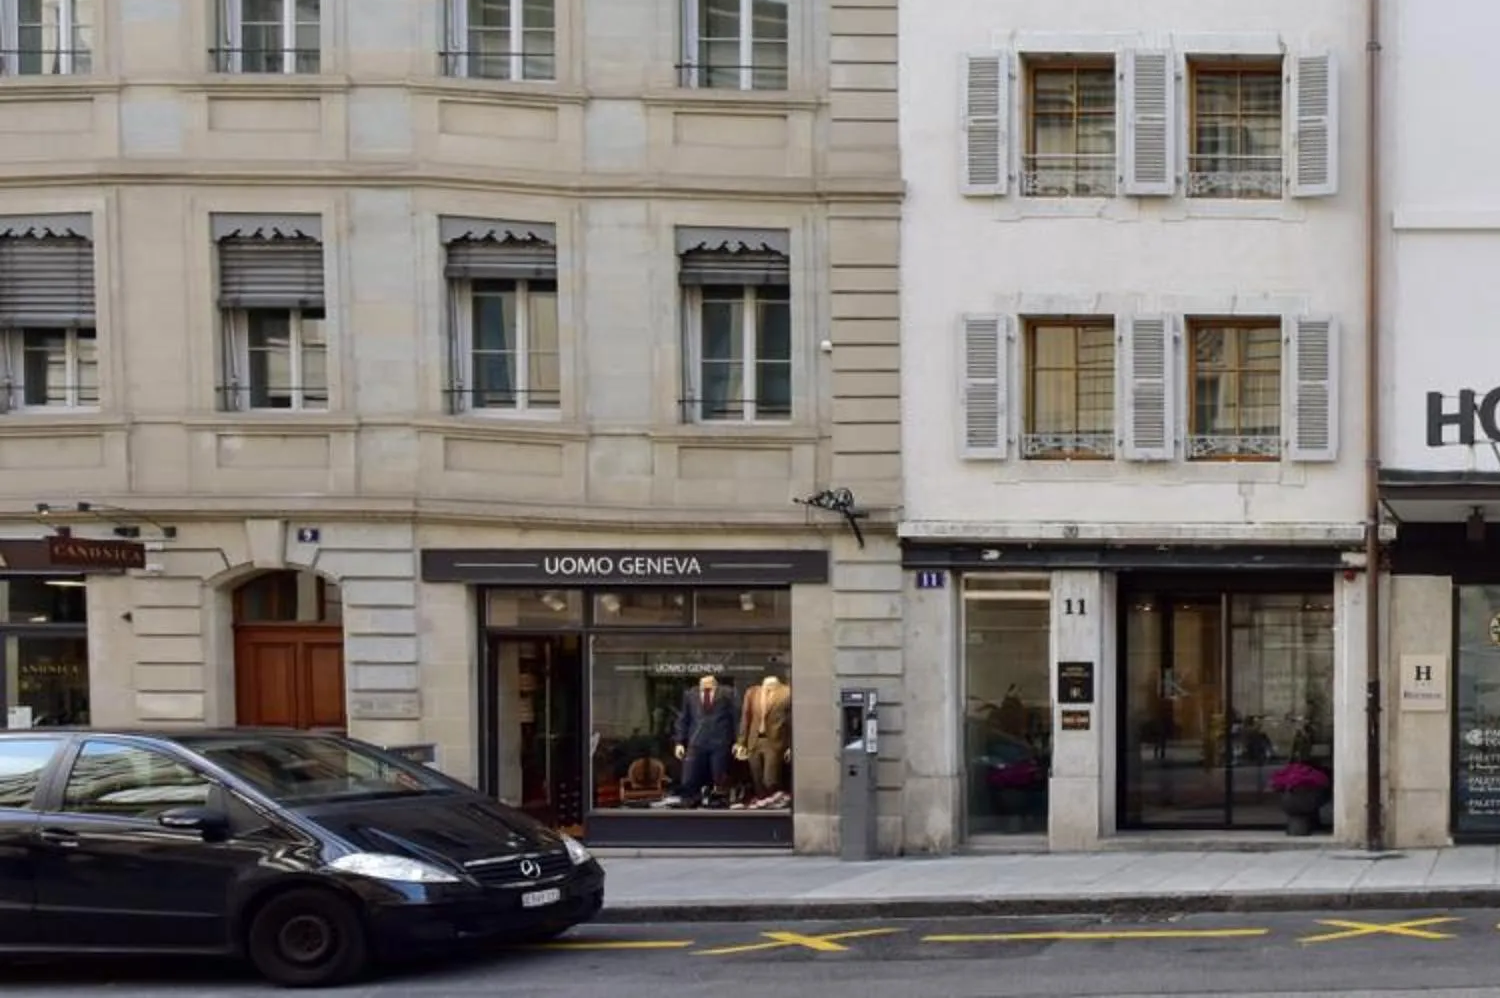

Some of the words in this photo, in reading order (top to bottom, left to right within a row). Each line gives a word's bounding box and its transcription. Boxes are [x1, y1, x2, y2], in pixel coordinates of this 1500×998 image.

[543, 557, 614, 576] UOMO
[618, 557, 702, 576] GENEVA
[1063, 598, 1088, 616] 11
[654, 663, 686, 674] UOMO
[687, 663, 725, 674] GENEVA
